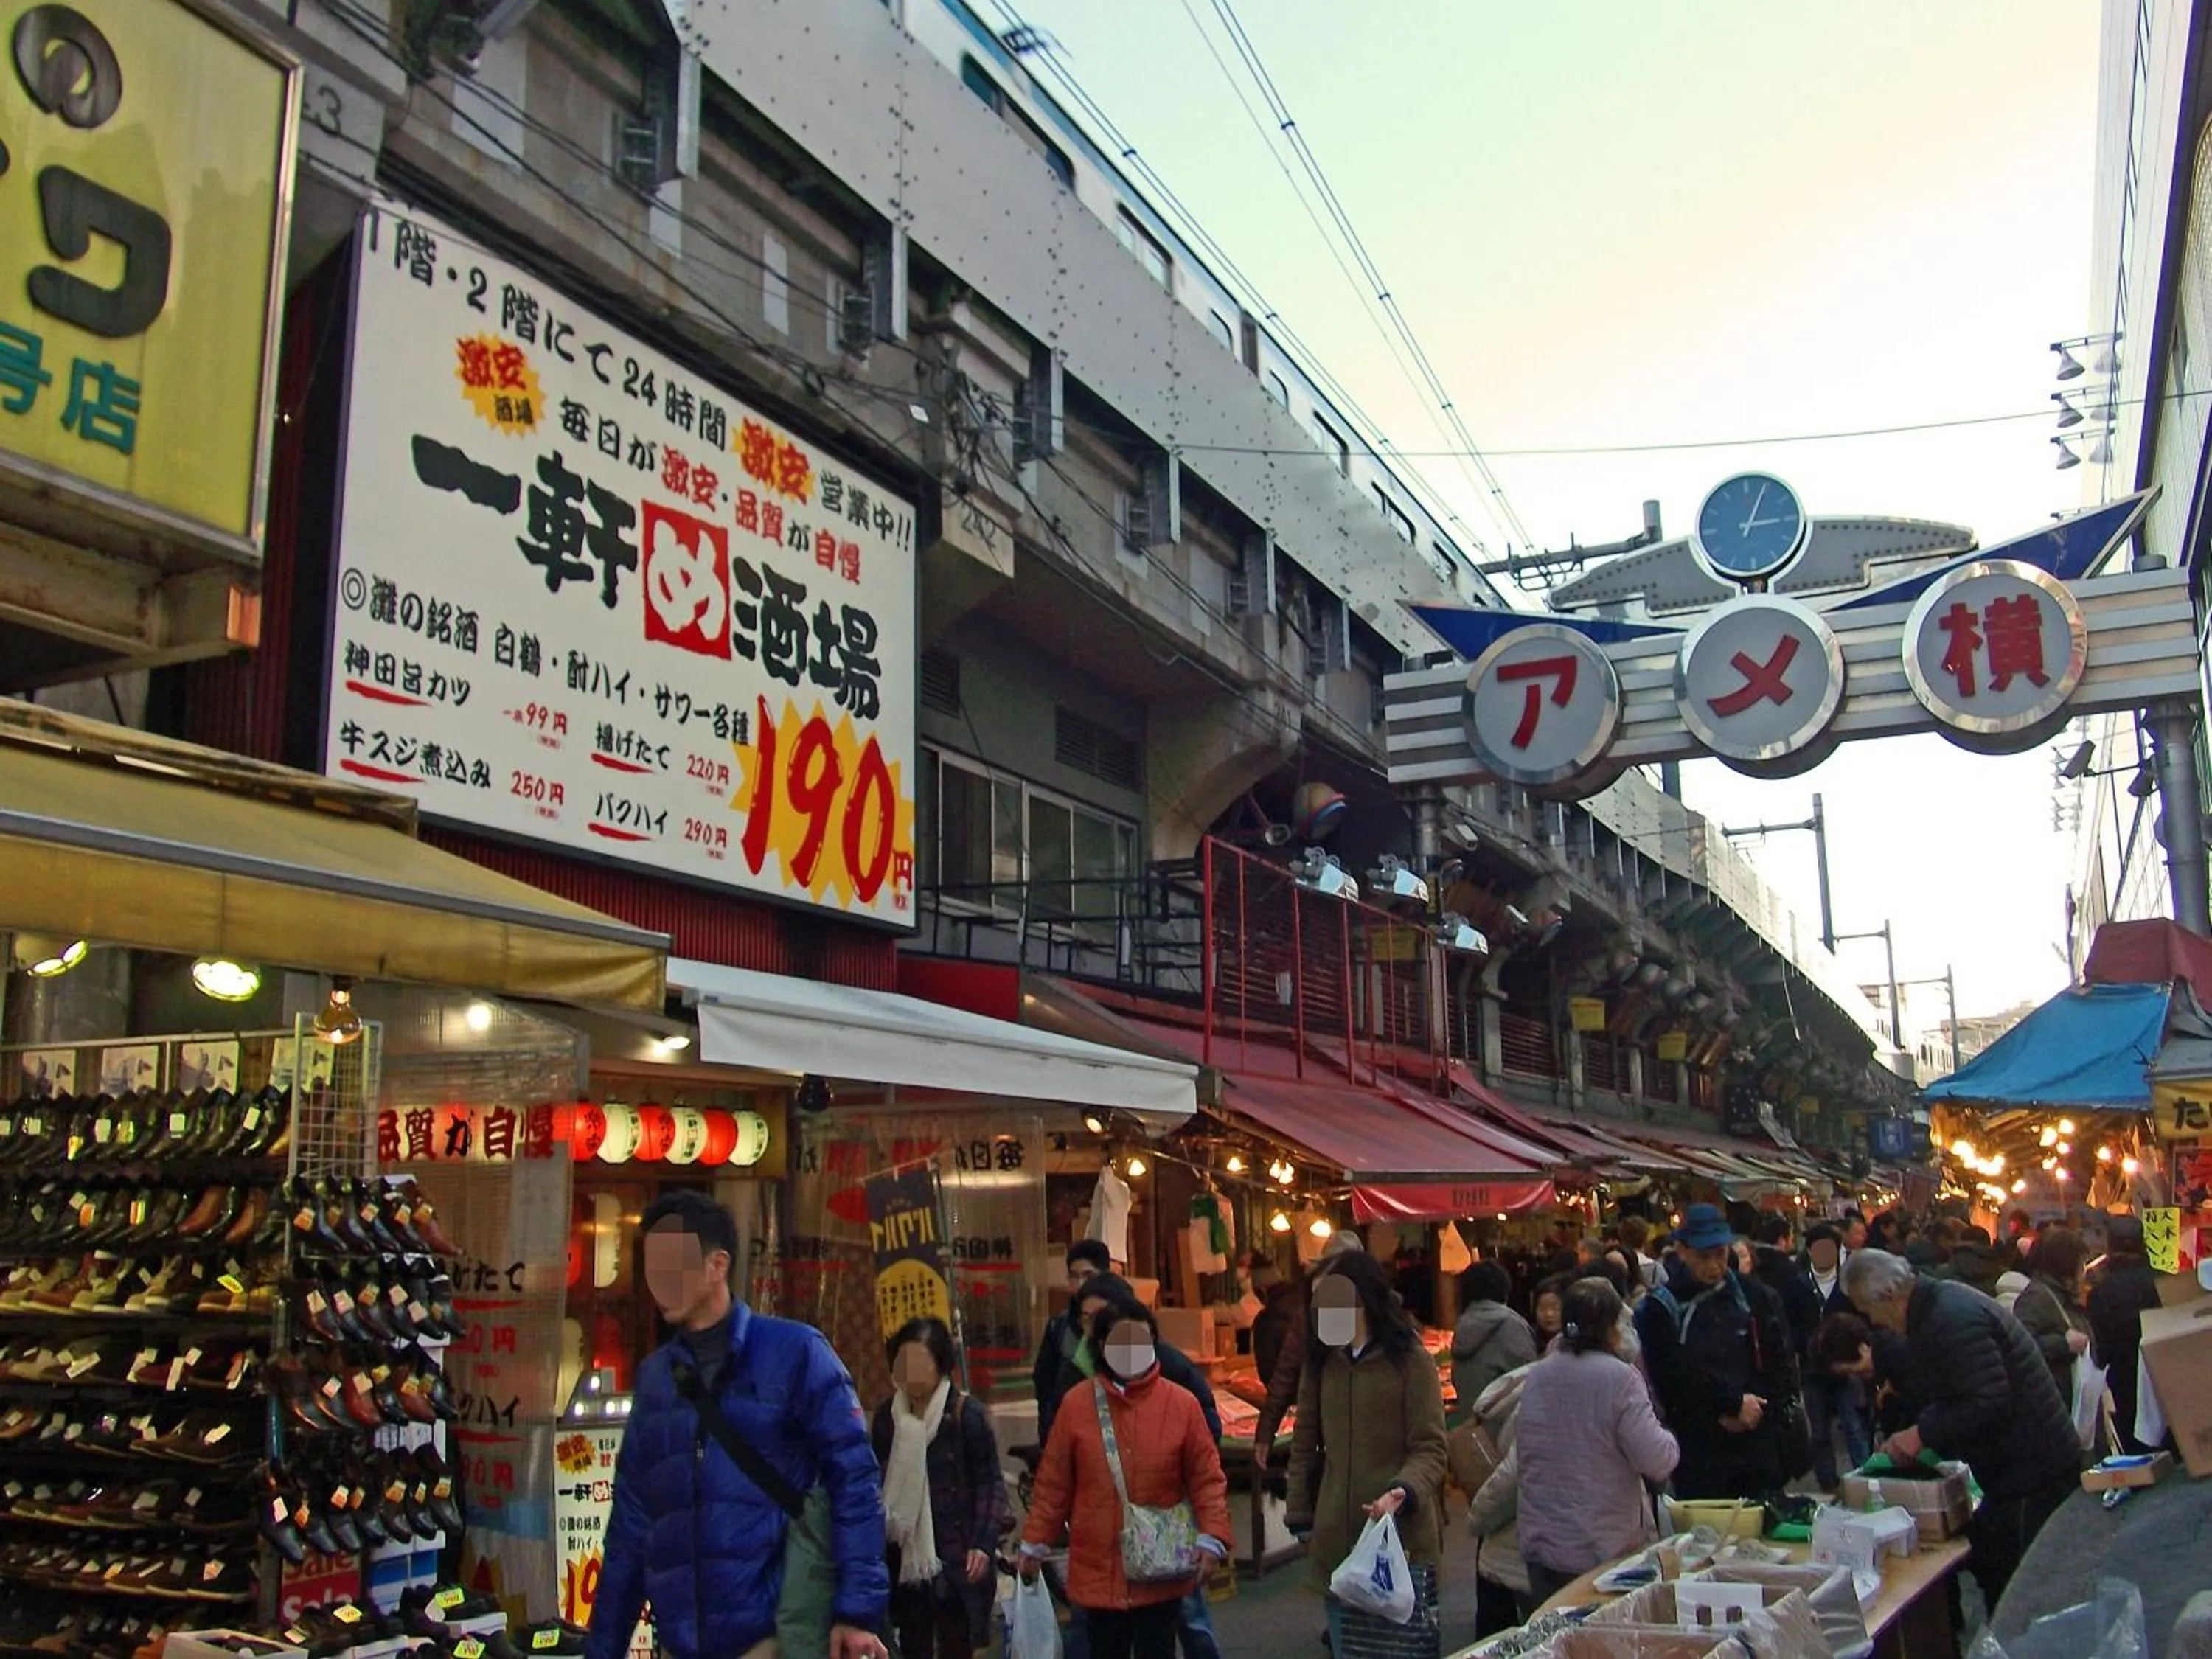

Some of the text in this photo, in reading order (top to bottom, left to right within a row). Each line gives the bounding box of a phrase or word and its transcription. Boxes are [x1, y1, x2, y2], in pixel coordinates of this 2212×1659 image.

[0, 138, 172, 338] コ
[1497, 592, 2051, 750] アメ横
[340, 720, 565, 806] 牛スジ煮込み 250円
[595, 721, 730, 785] 揚げたて 220円
[595, 792, 727, 849] バクハイ 290円
[2171, 1095, 2212, 1131] た
